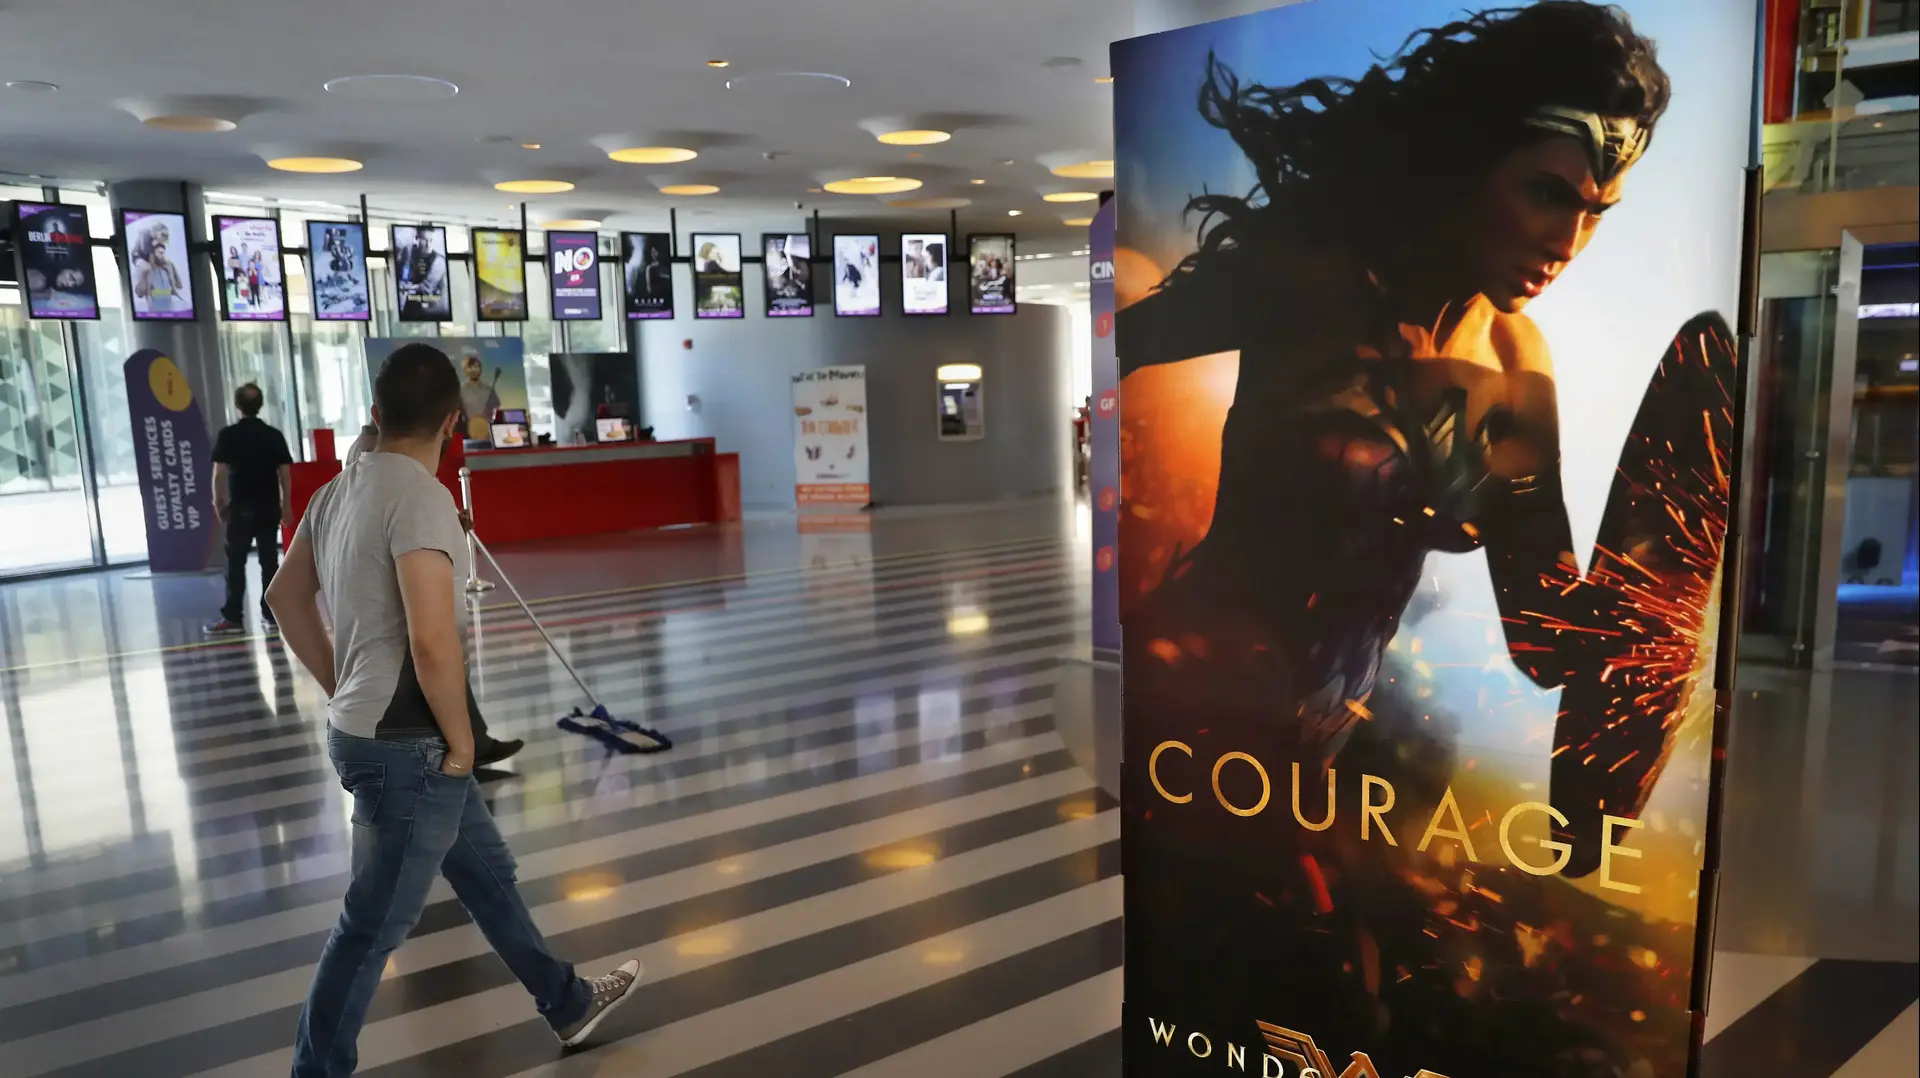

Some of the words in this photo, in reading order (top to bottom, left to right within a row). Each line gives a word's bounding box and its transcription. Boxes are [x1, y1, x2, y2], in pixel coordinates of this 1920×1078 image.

[554, 246, 594, 274] NO
[1101, 398, 1115, 411] GF
[144, 416, 164, 480] SERVICES
[161, 419, 177, 466] CARDS
[179, 440, 197, 496] TICKETS
[153, 485, 169, 530] GUEST
[168, 472, 185, 530] LOYALTY
[187, 506, 201, 530] VIP
[1148, 739, 1645, 895] COURAGE
